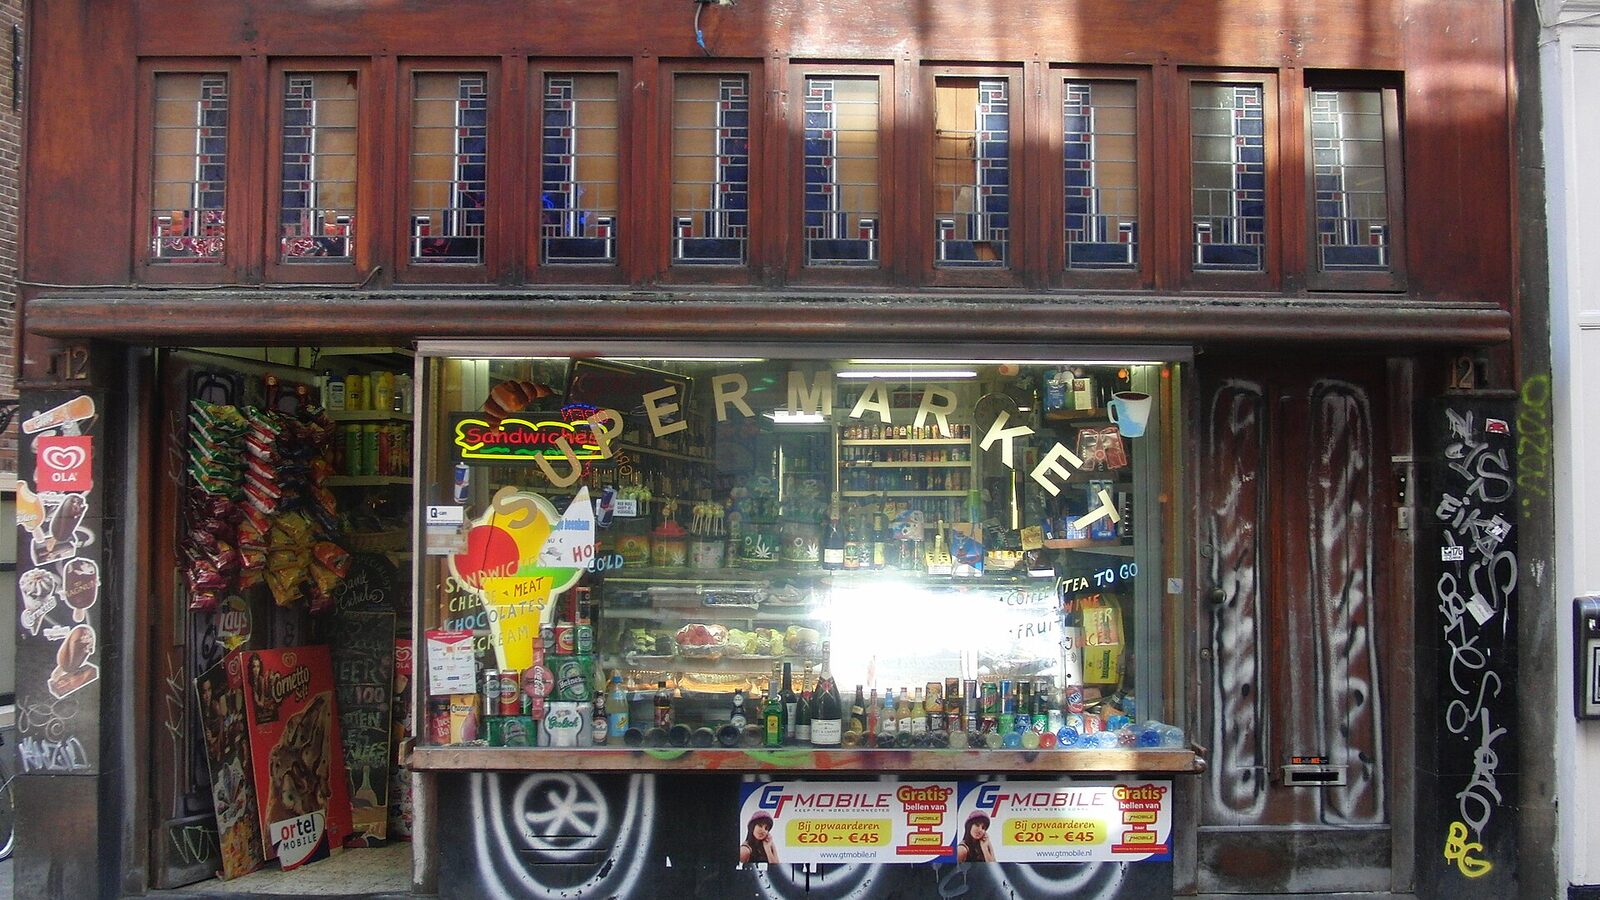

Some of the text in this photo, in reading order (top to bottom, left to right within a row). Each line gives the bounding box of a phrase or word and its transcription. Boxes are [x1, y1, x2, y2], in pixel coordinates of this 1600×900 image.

[1450, 356, 1473, 390] 12
[52, 472, 76, 482] OLA
[573, 542, 602, 563] HOT
[587, 555, 625, 574] COLD
[1094, 568, 1114, 587] TO
[1119, 562, 1138, 579] GO
[513, 576, 545, 598] MEAT
[445, 597, 545, 632] CHOCOLATES
[1017, 619, 1063, 640] FRUIT
[899, 786, 947, 802] Gratis
[976, 785, 1108, 818] GT MOBILE
[1113, 785, 1161, 801] Gratis
[758, 785, 893, 819] GT MOBILE
[905, 803, 929, 811] bellen
[1119, 802, 1144, 810] bellen
[281, 814, 316, 840] ortel
[798, 821, 880, 832] Bij opwaarderen
[1014, 820, 1096, 831] Bij opwaarderen
[283, 833, 318, 851] MOBILE
[797, 833, 879, 844] €20 €45
[1014, 831, 1095, 843] €20 €45
[820, 850, 877, 860] www.gtmobile.nl
[1036, 849, 1092, 859] www.gtmobile.nl
